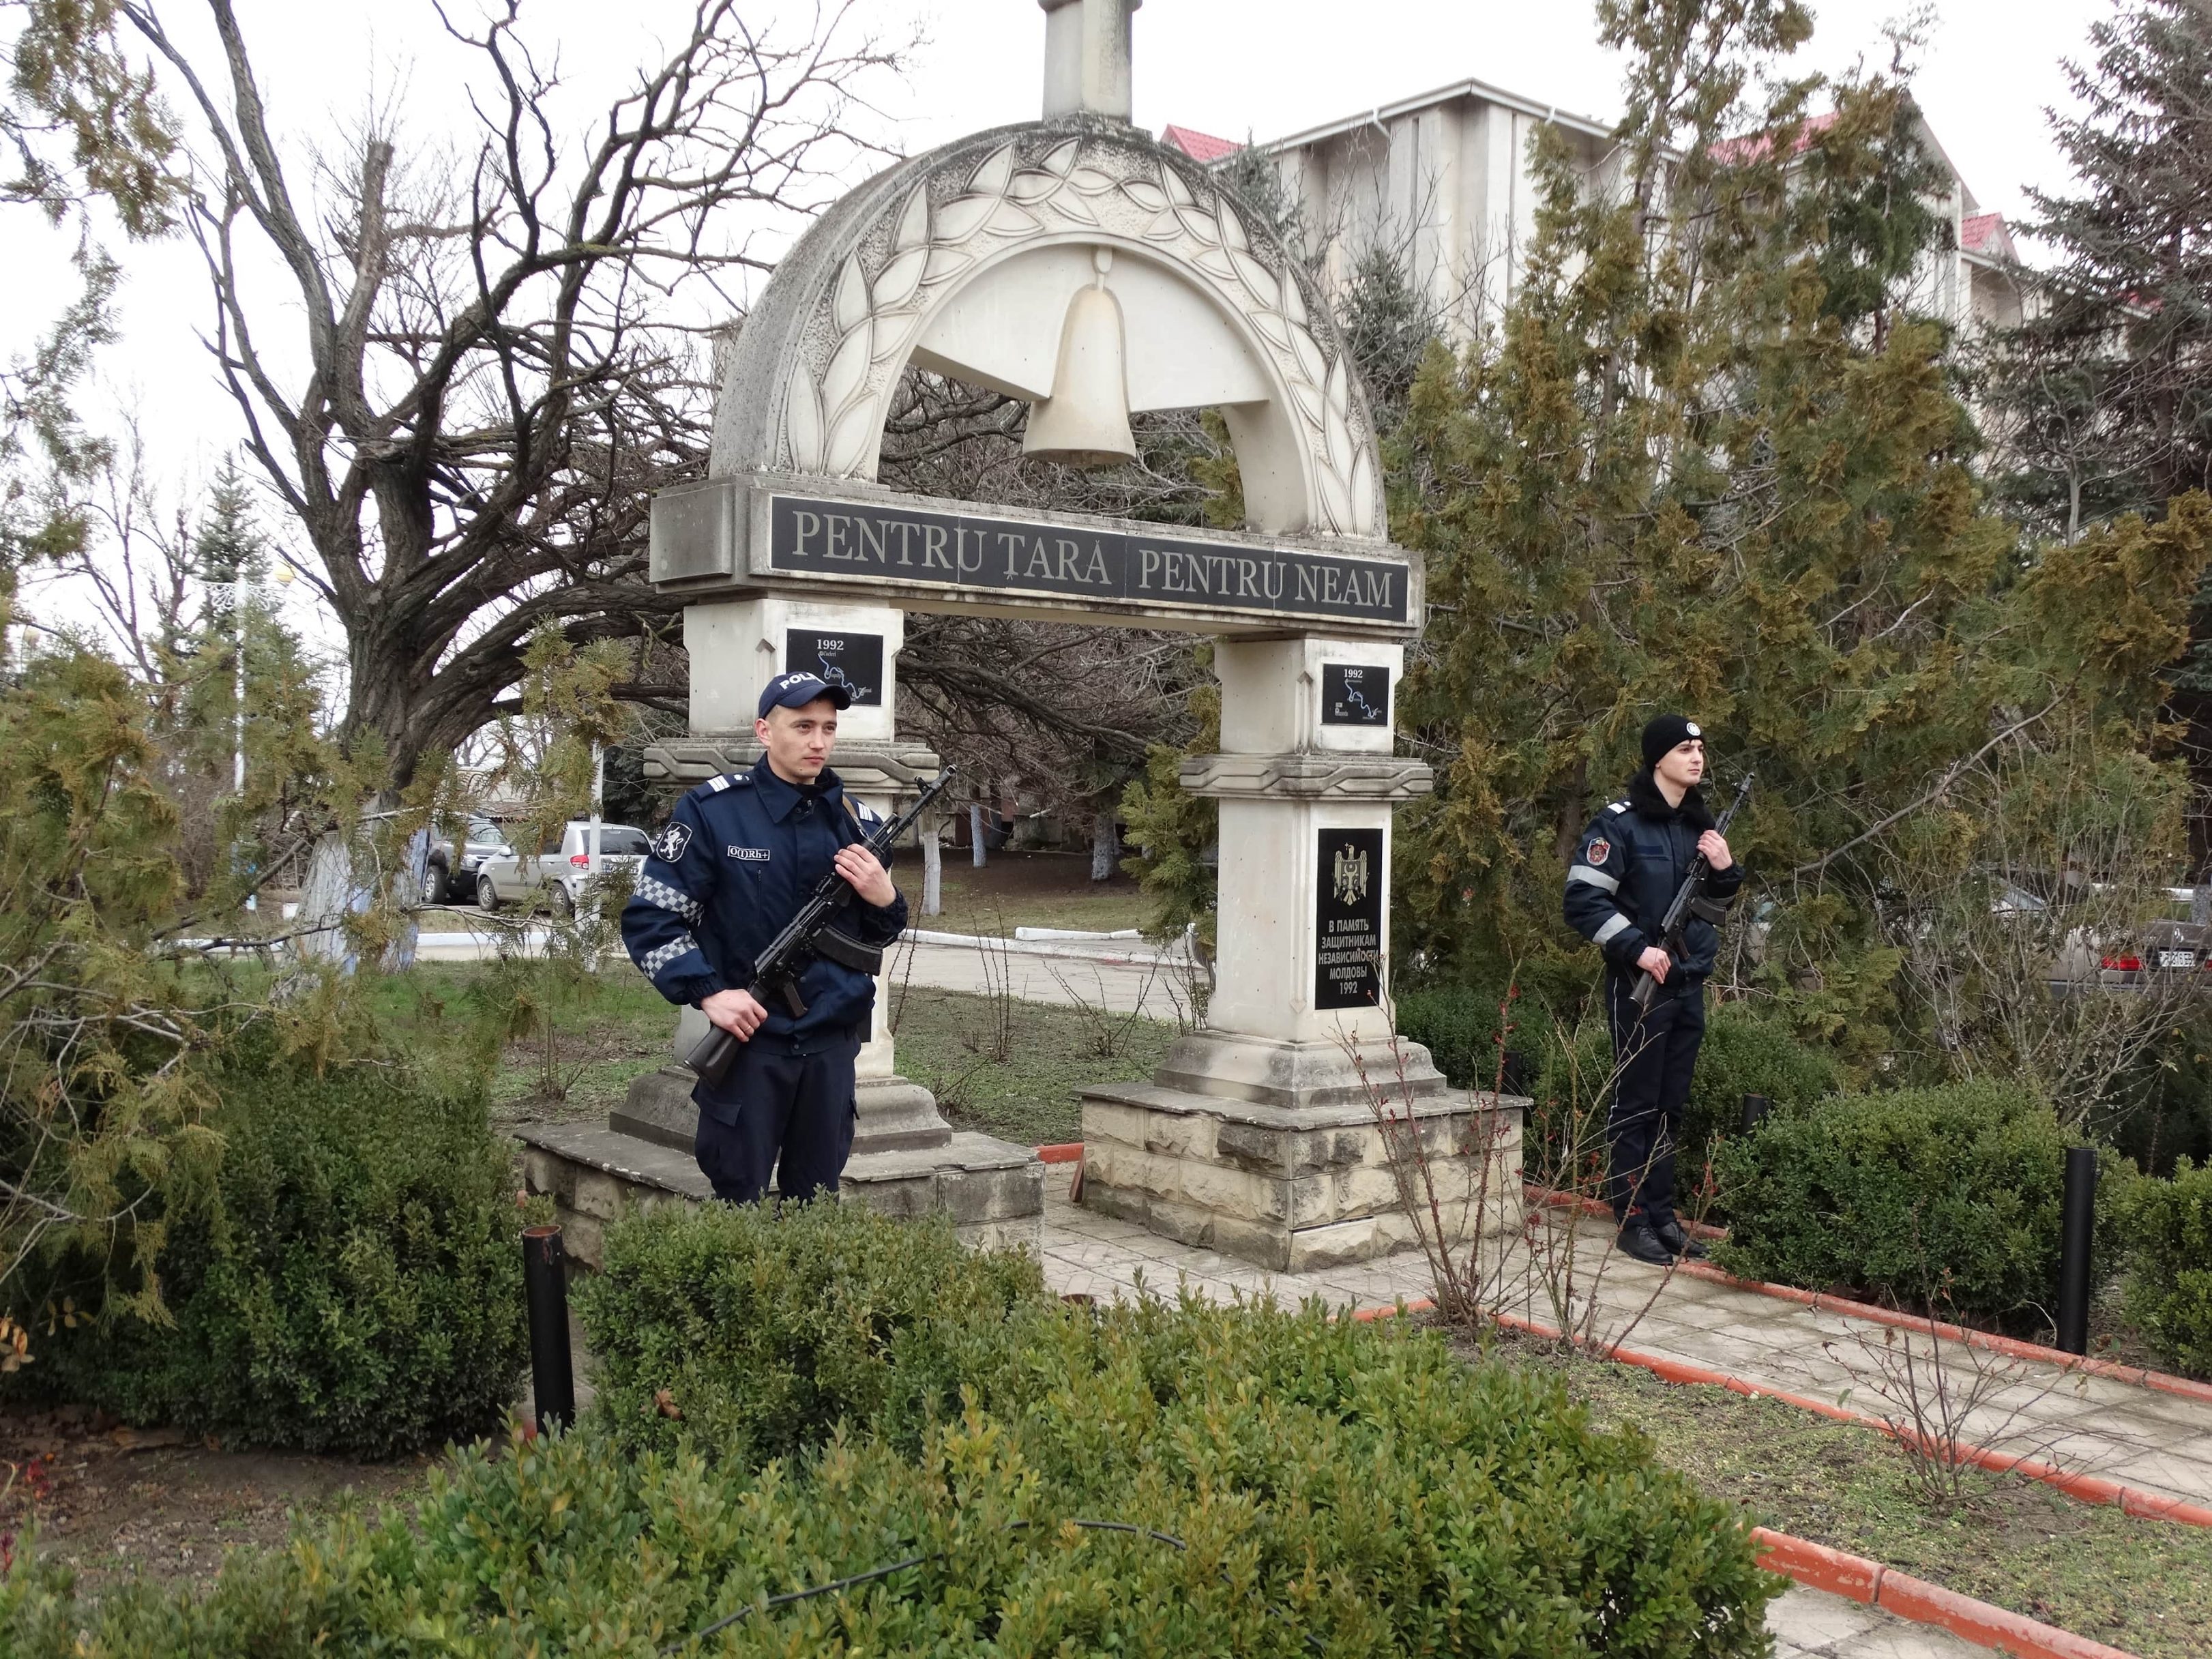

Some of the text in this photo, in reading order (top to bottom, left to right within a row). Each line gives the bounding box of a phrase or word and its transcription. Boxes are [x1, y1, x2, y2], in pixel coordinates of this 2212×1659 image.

[792, 510, 987, 572] PENTRU
[1138, 549, 1286, 599] PENTRU
[1295, 563, 1393, 608] NEAM
[817, 639, 844, 650] 1992
[780, 672, 816, 690] POLI
[1344, 669, 1363, 678] 1992
[1329, 918, 1369, 933] В ПАМЯТЬ
[1321, 934, 1376, 950] ЗАЩИТНИКАМ
[1318, 950, 1378, 965] НЕЗАВИСИМОСТИ
[1329, 966, 1367, 980] МОЛДОВЫ
[1340, 981, 1357, 995] 1992
